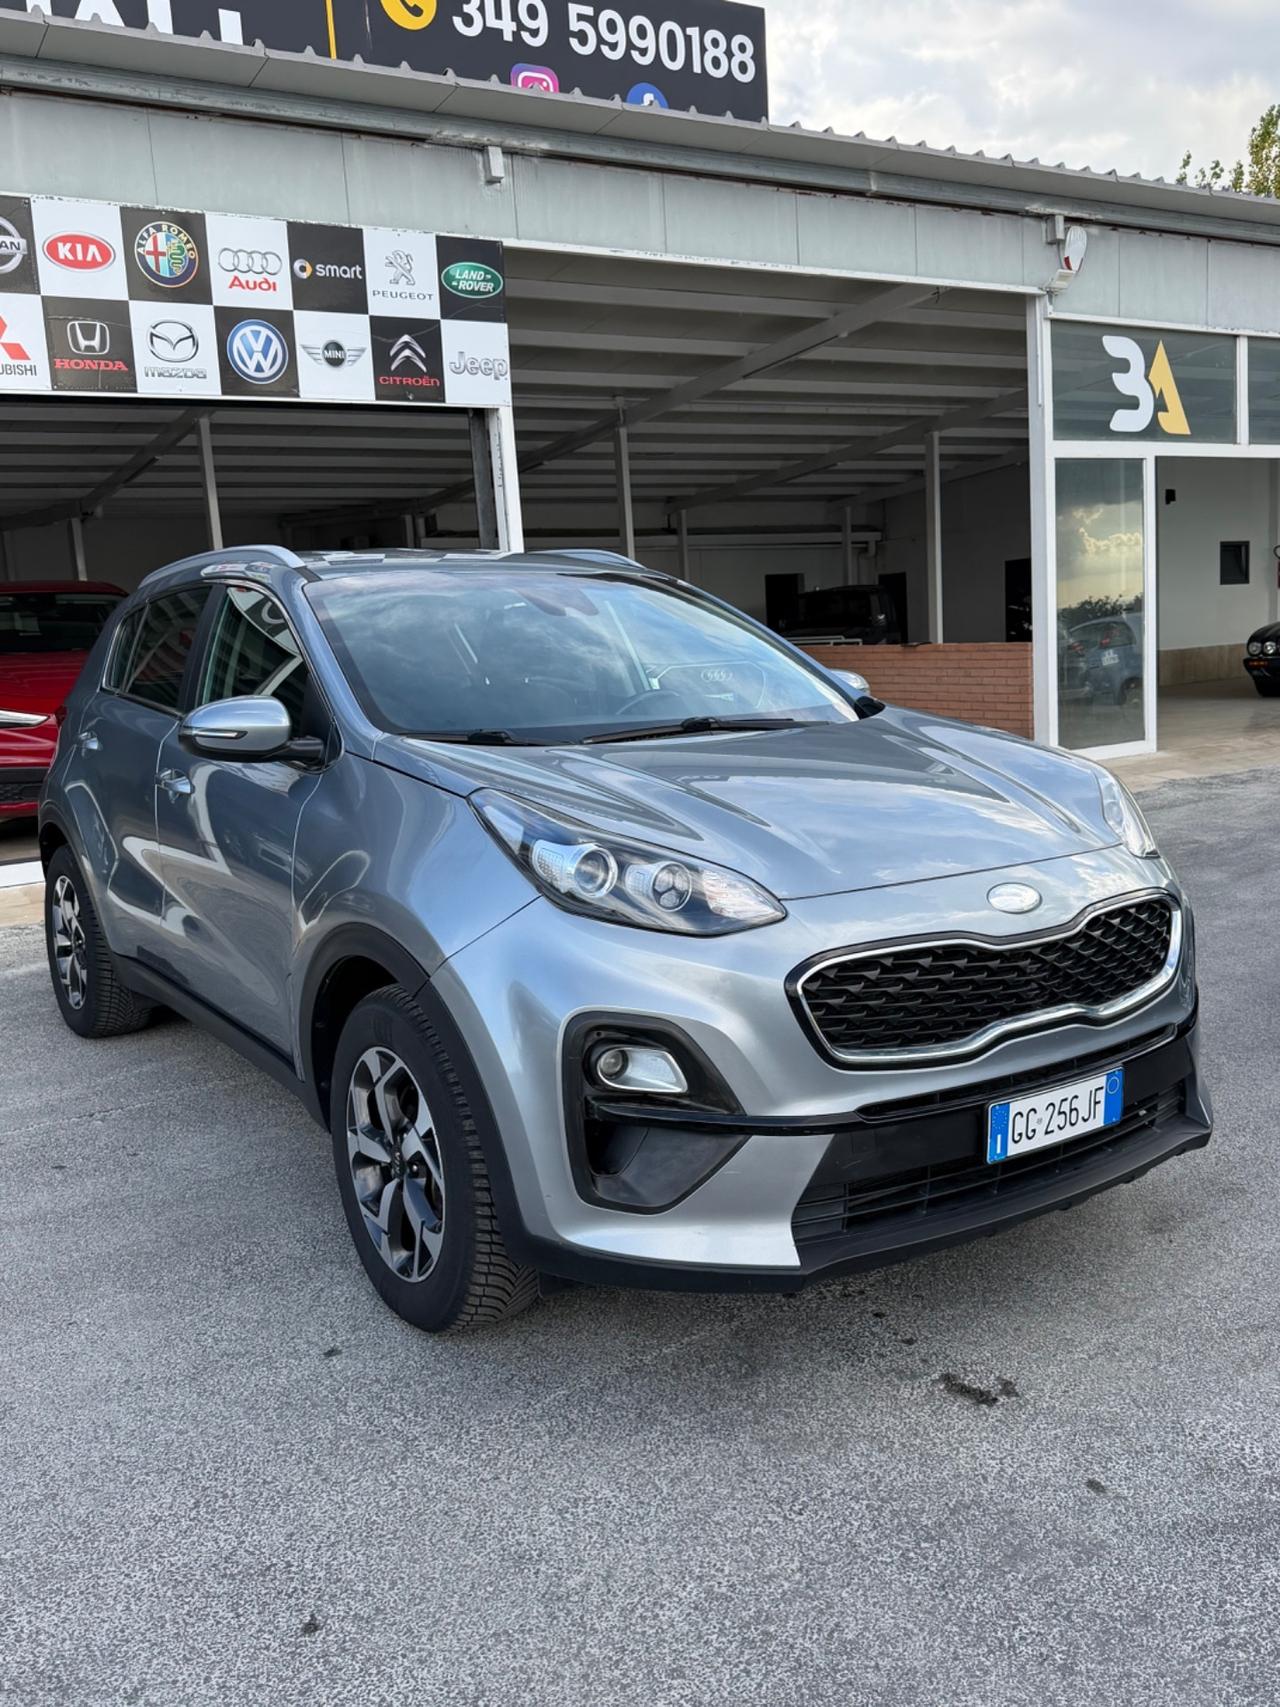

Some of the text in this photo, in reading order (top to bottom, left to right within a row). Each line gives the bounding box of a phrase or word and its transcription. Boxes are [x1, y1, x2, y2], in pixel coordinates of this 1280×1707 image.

[452, 0, 756, 84] 349 5990188
[137, 224, 196, 259] ALFA ROMEO
[57, 242, 103, 262] KIA
[315, 264, 362, 279] smart
[455, 270, 485, 280] LAND
[228, 275, 277, 292] Audi
[458, 281, 494, 293] ROVER
[372, 290, 433, 301] PEUGEOT
[323, 348, 345, 360] MINI
[54, 358, 128, 371] HONDA
[449, 351, 508, 381] Jeep
[1012, 1108, 1038, 1144] GG
